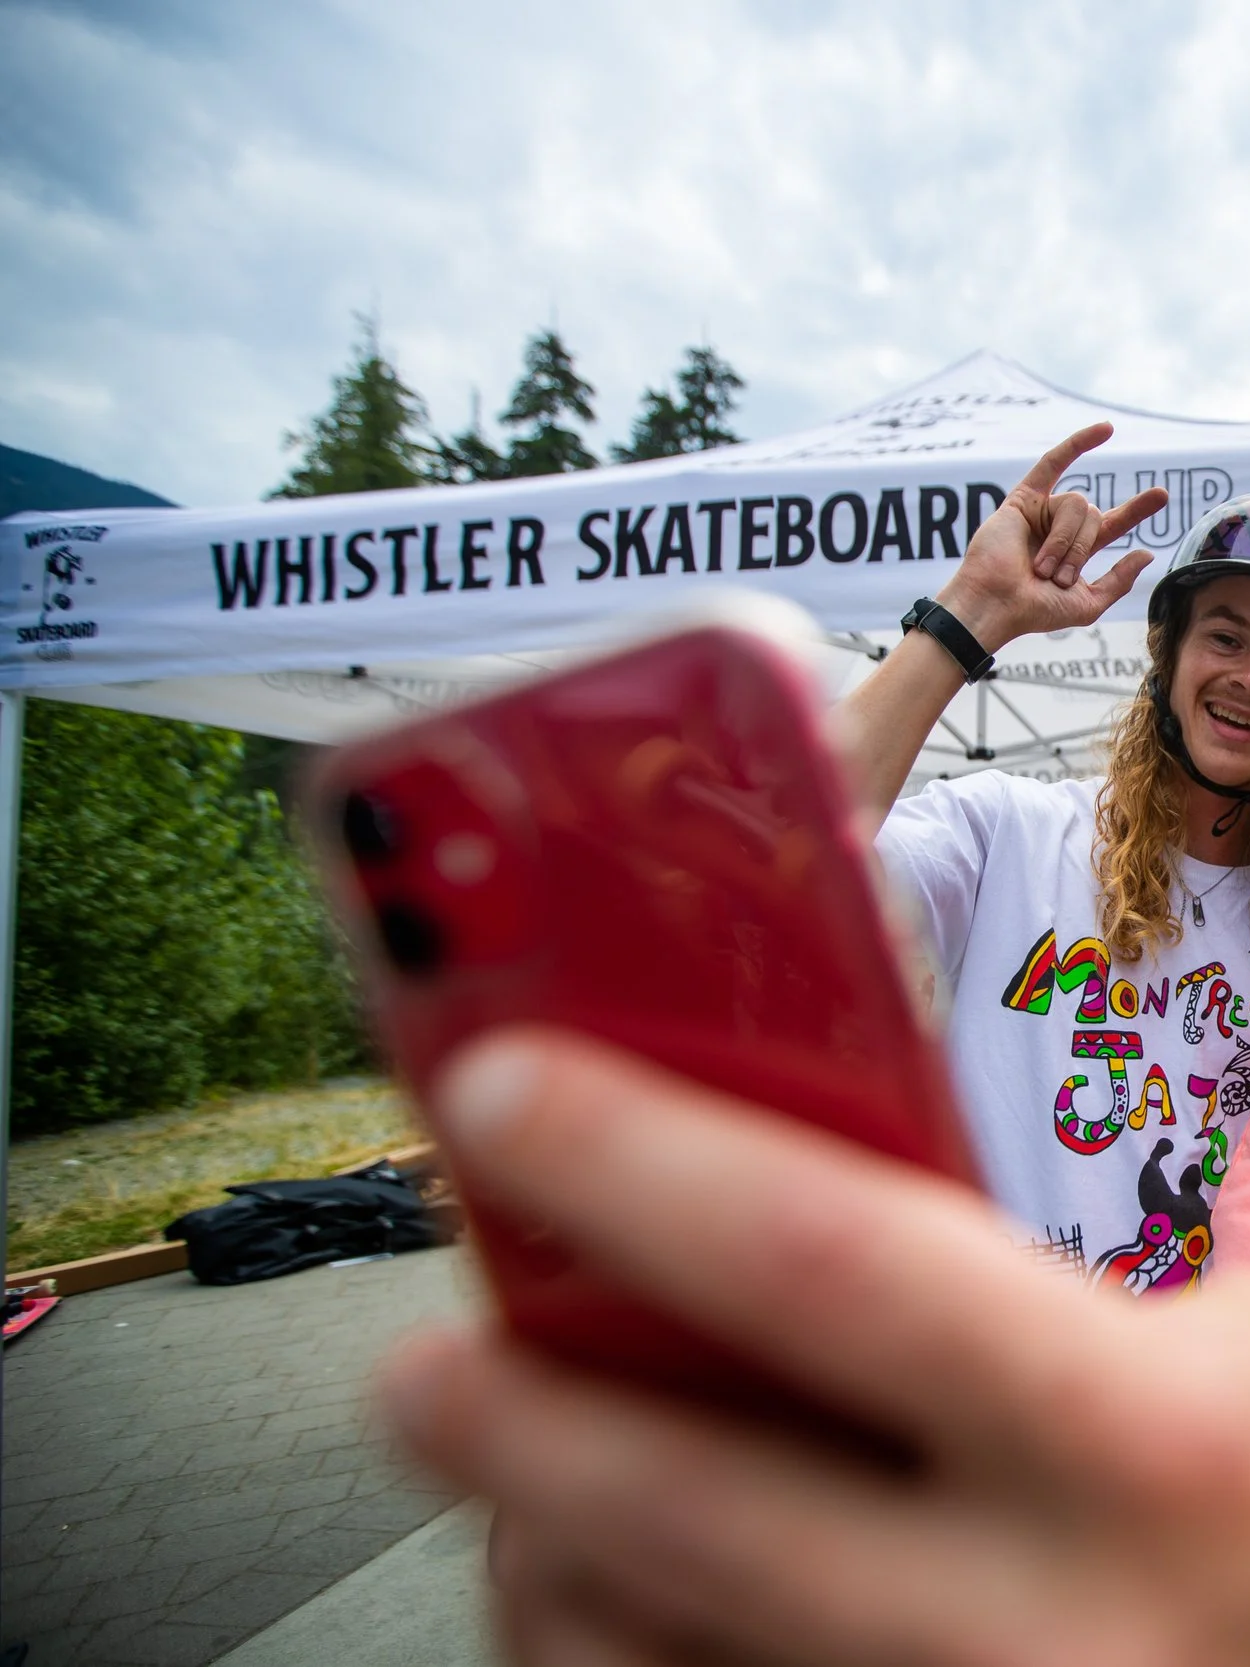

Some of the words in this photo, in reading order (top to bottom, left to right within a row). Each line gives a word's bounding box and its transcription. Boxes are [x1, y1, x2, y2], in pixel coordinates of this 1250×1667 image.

[210, 515, 546, 611] WHISTLER
[577, 482, 1009, 580] SKATEBOARD
[1051, 467, 1234, 549] LUB
